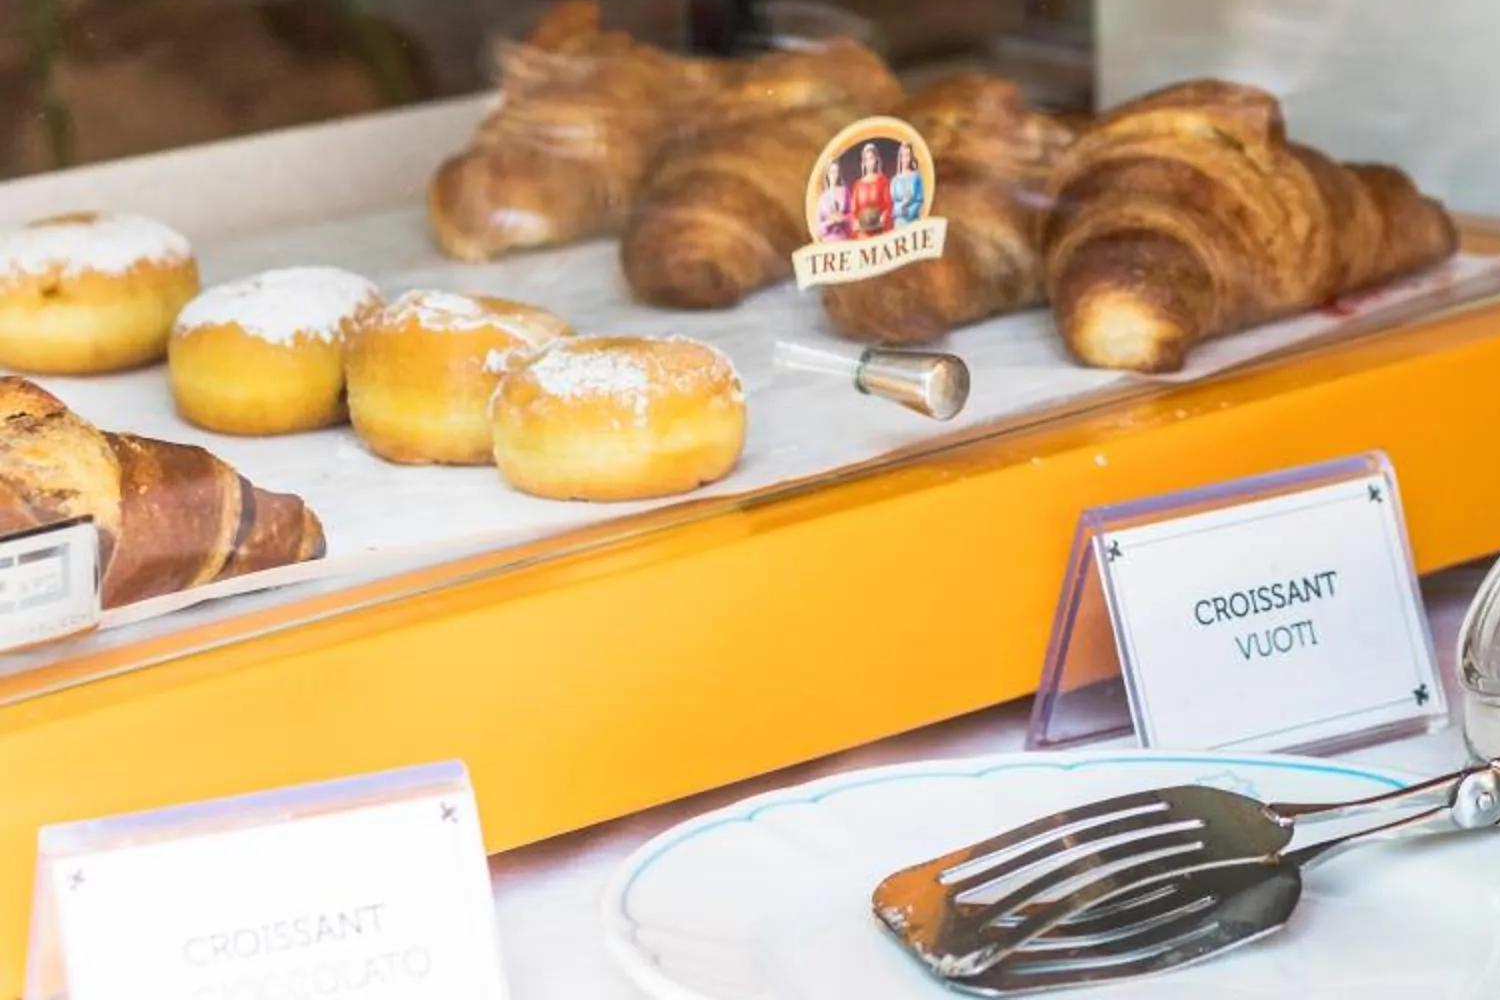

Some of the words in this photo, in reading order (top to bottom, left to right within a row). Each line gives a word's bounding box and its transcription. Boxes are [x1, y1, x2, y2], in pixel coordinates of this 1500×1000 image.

[807, 252, 851, 275] TRE
[860, 229, 933, 267] MARIE
[1194, 571, 1338, 626] CROISSANT
[1235, 620, 1319, 661] VUOTI
[182, 902, 386, 967] CROISSANT
